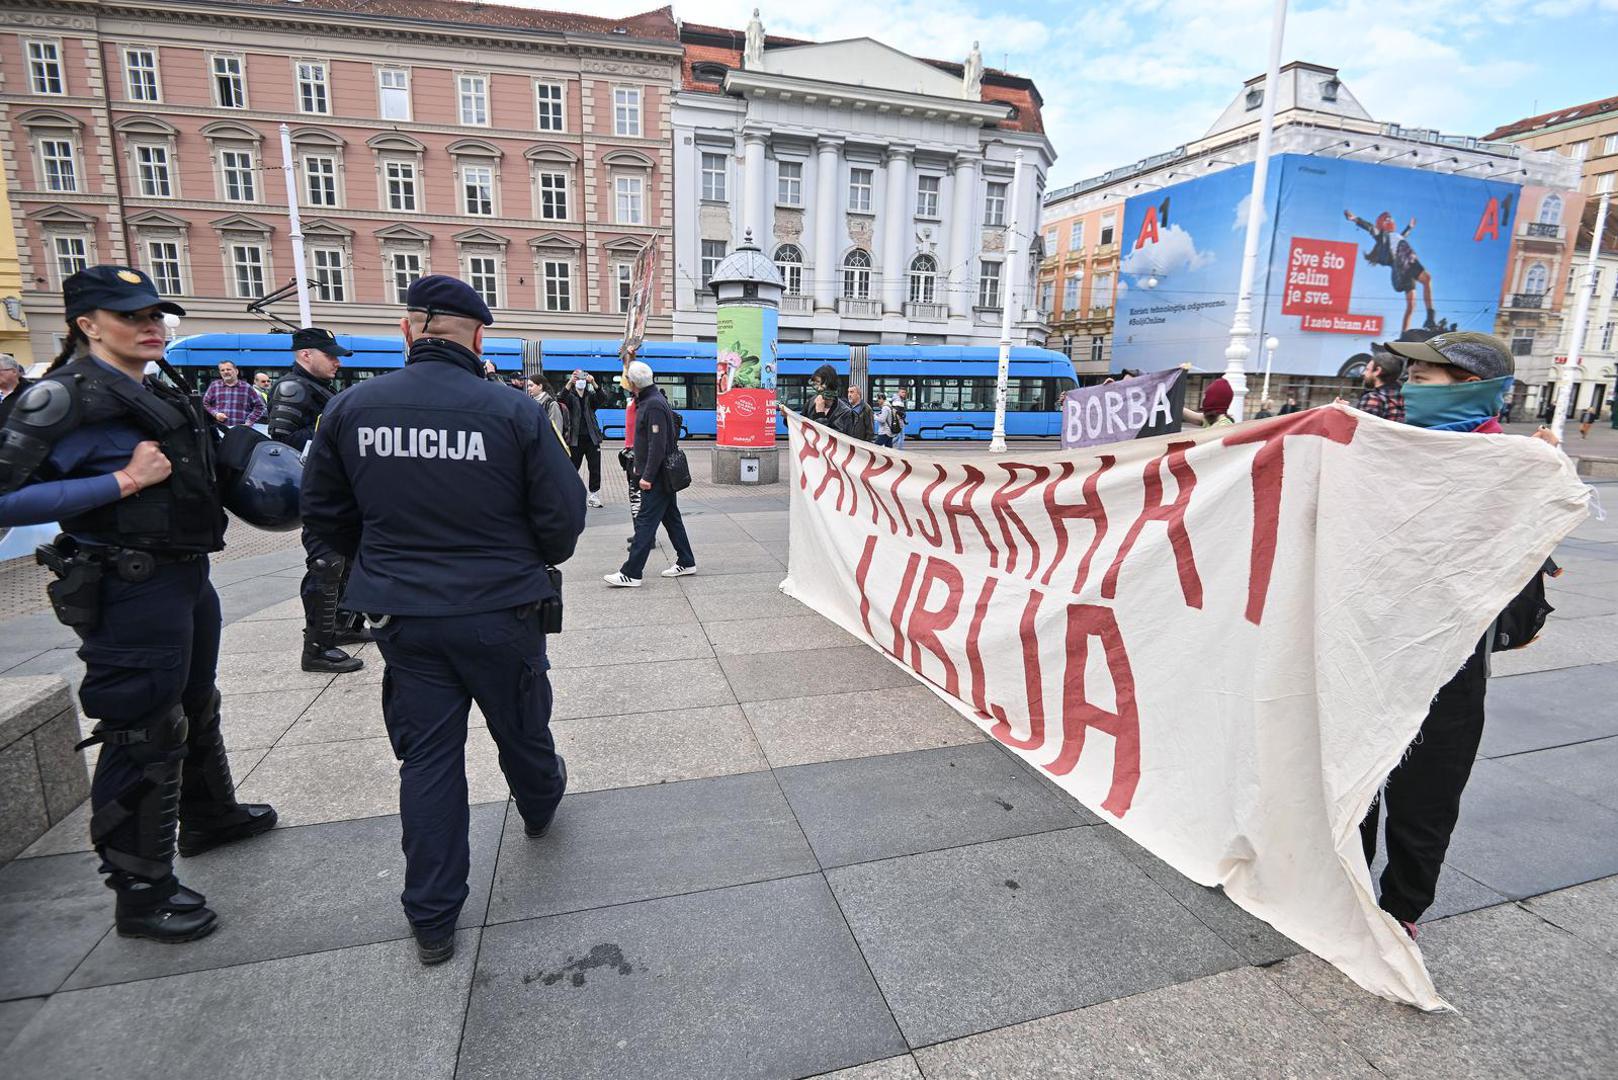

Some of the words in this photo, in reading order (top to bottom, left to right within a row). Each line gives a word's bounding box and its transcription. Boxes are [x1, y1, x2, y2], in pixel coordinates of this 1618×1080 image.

[1135, 196, 1170, 249] A1
[1473, 192, 1513, 241] A1
[1292, 247, 1320, 267] Sve
[1322, 251, 1345, 269] što
[1289, 267, 1329, 286] želim
[1286, 285, 1302, 307] je
[1304, 291, 1333, 305] sve.
[1310, 317, 1332, 328] zato
[1333, 316, 1362, 330] biram
[1066, 382, 1173, 443] BORBA
[357, 426, 487, 461] POLICIJA
